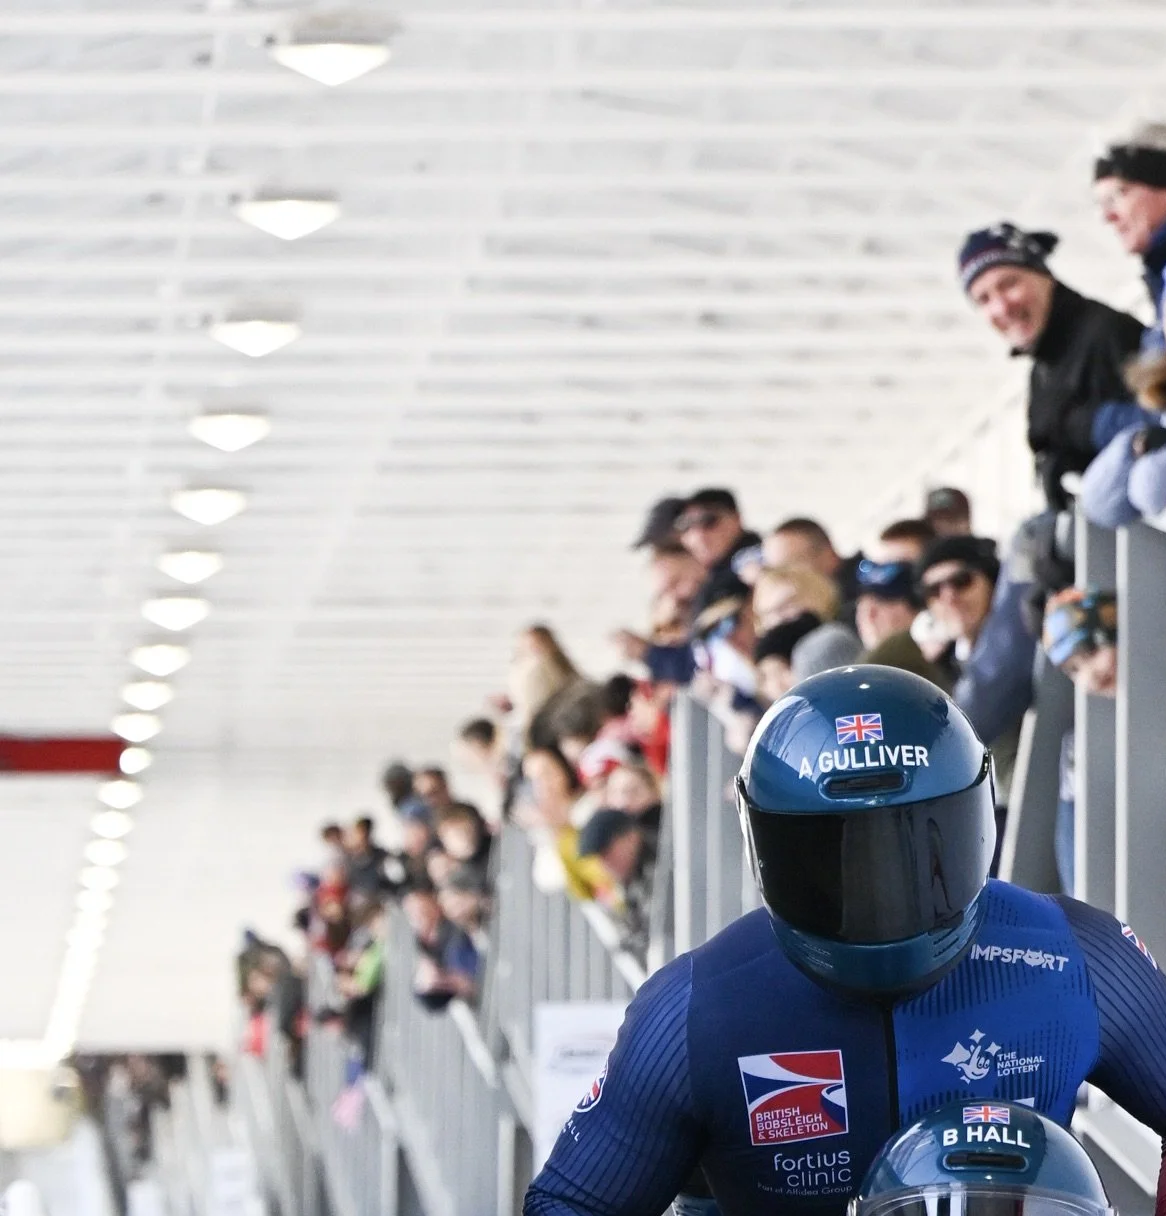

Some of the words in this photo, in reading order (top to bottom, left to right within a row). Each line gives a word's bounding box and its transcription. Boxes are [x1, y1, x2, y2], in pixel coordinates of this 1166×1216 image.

[798, 757, 813, 779] A
[818, 745, 929, 773] GULLIVER
[970, 943, 1070, 972] IMPSPORT
[997, 1051, 1017, 1061] THE
[997, 1056, 1045, 1069] NATIONAL
[997, 1064, 1040, 1077] LOTTERY
[755, 1106, 801, 1122] BRITISH
[757, 1113, 823, 1131] BOBSLEIGH
[758, 1131, 766, 1140] &
[768, 1121, 829, 1139] SKELETON
[943, 1129, 958, 1147] B
[966, 1125, 1031, 1149] HALL
[774, 1150, 851, 1171] fortius
[787, 1168, 852, 1187] clinic
